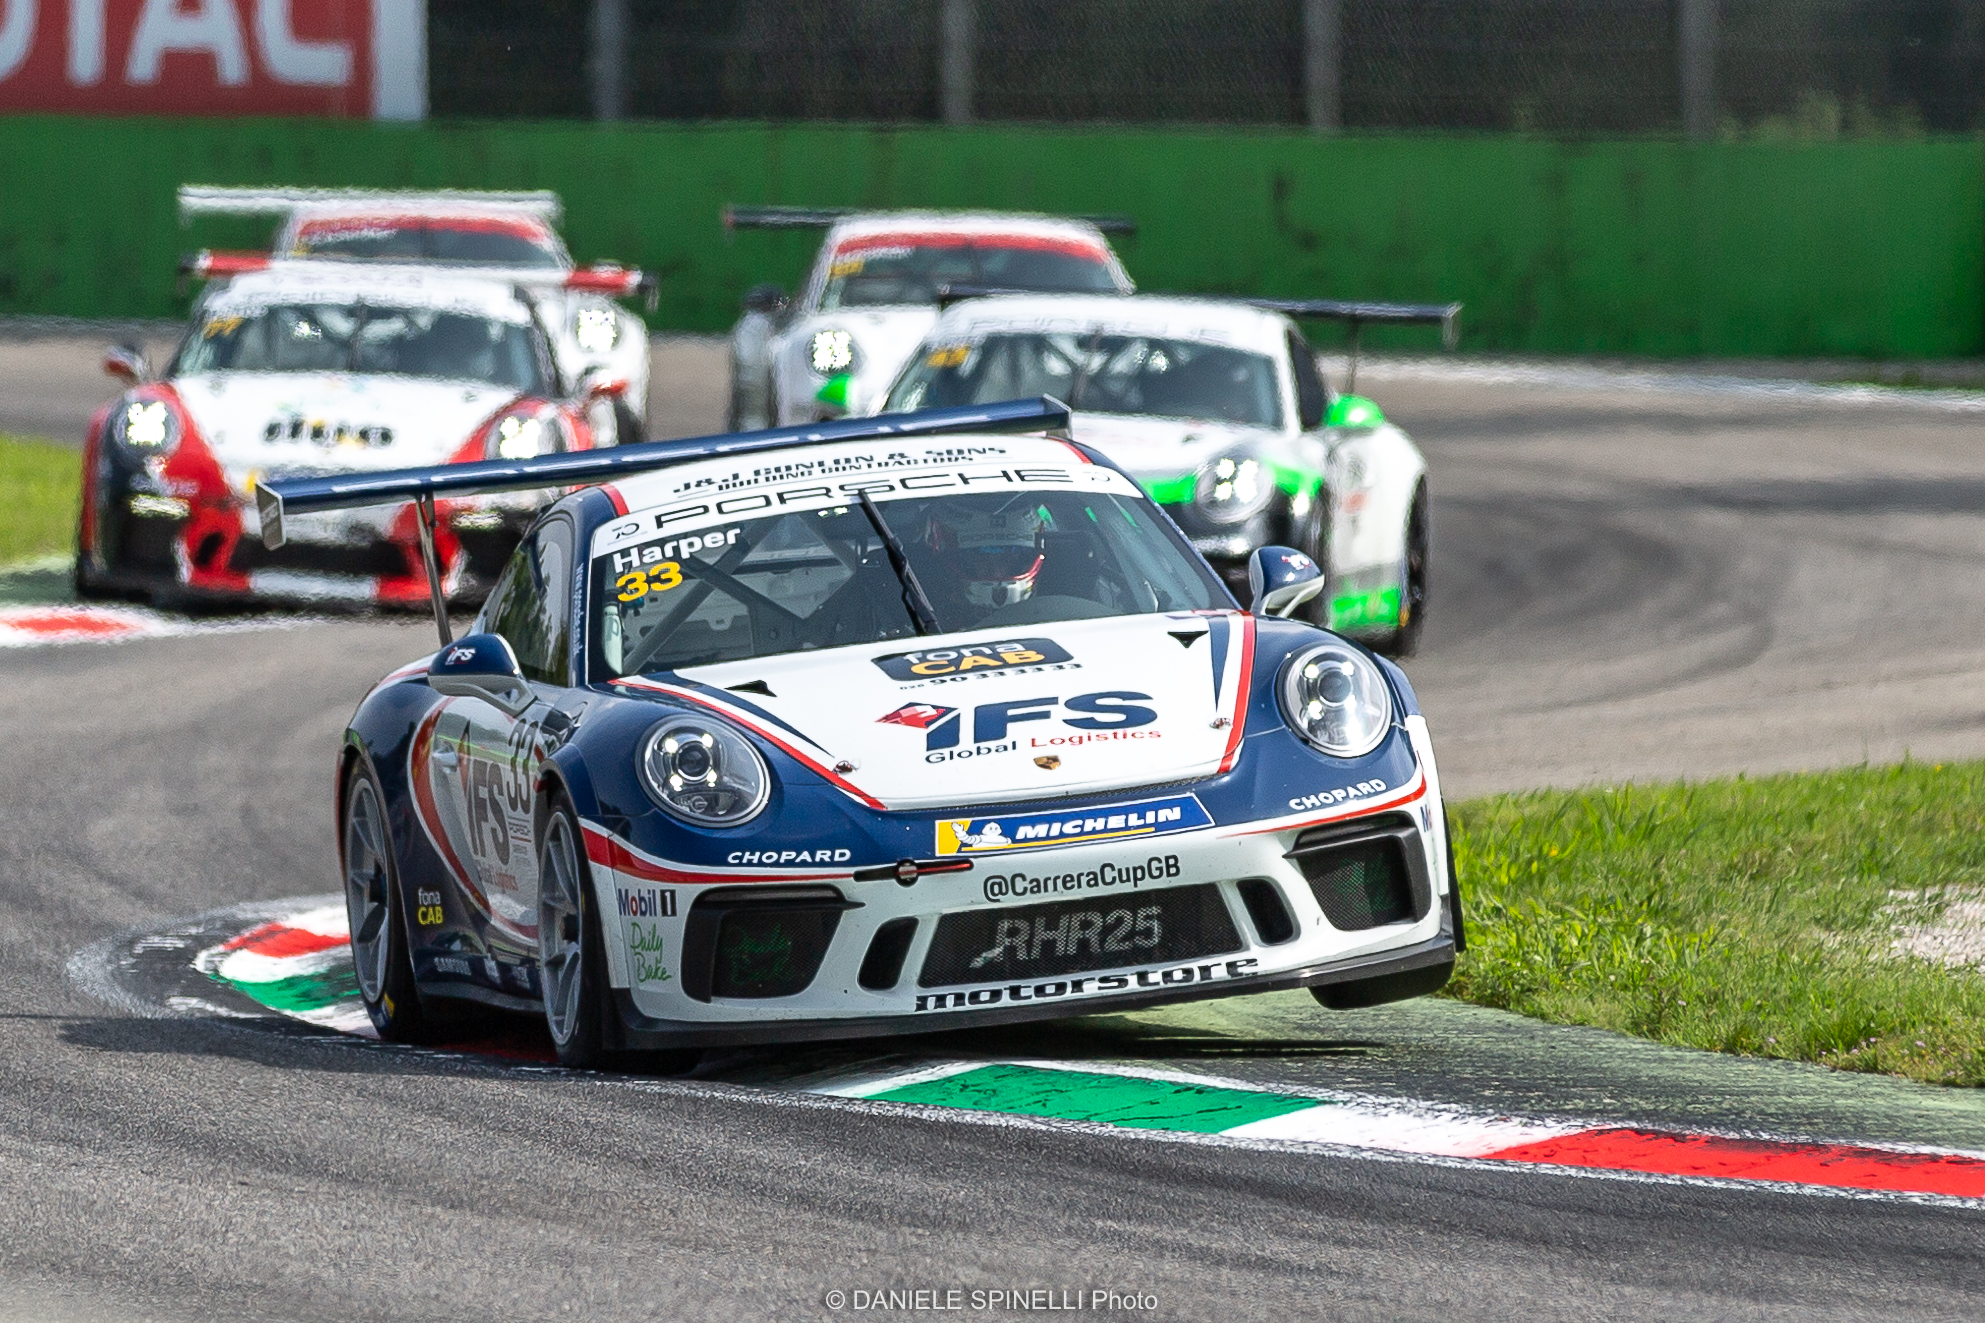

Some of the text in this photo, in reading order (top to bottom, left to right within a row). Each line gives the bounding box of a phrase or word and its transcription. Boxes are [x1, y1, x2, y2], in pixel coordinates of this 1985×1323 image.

[654, 469, 1074, 530] PORSCHE
[612, 527, 741, 574] Harper
[616, 561, 683, 602] 33
[903, 642, 1026, 664] fona
[910, 650, 1046, 675] CAB
[925, 729, 1162, 764] Global Logistics
[506, 717, 541, 815] 33
[1288, 778, 1388, 811] CHOPARD
[1016, 806, 1181, 840] MICHELIN
[727, 848, 852, 864] CHOPARD
[983, 854, 1181, 903] @CarreraCupGB
[418, 887, 441, 906] fona
[618, 888, 677, 917] Mobil 1
[418, 906, 443, 925] CAB
[630, 921, 664, 963] Daily
[633, 951, 673, 983] Bake
[915, 957, 1259, 1012] motorstore
